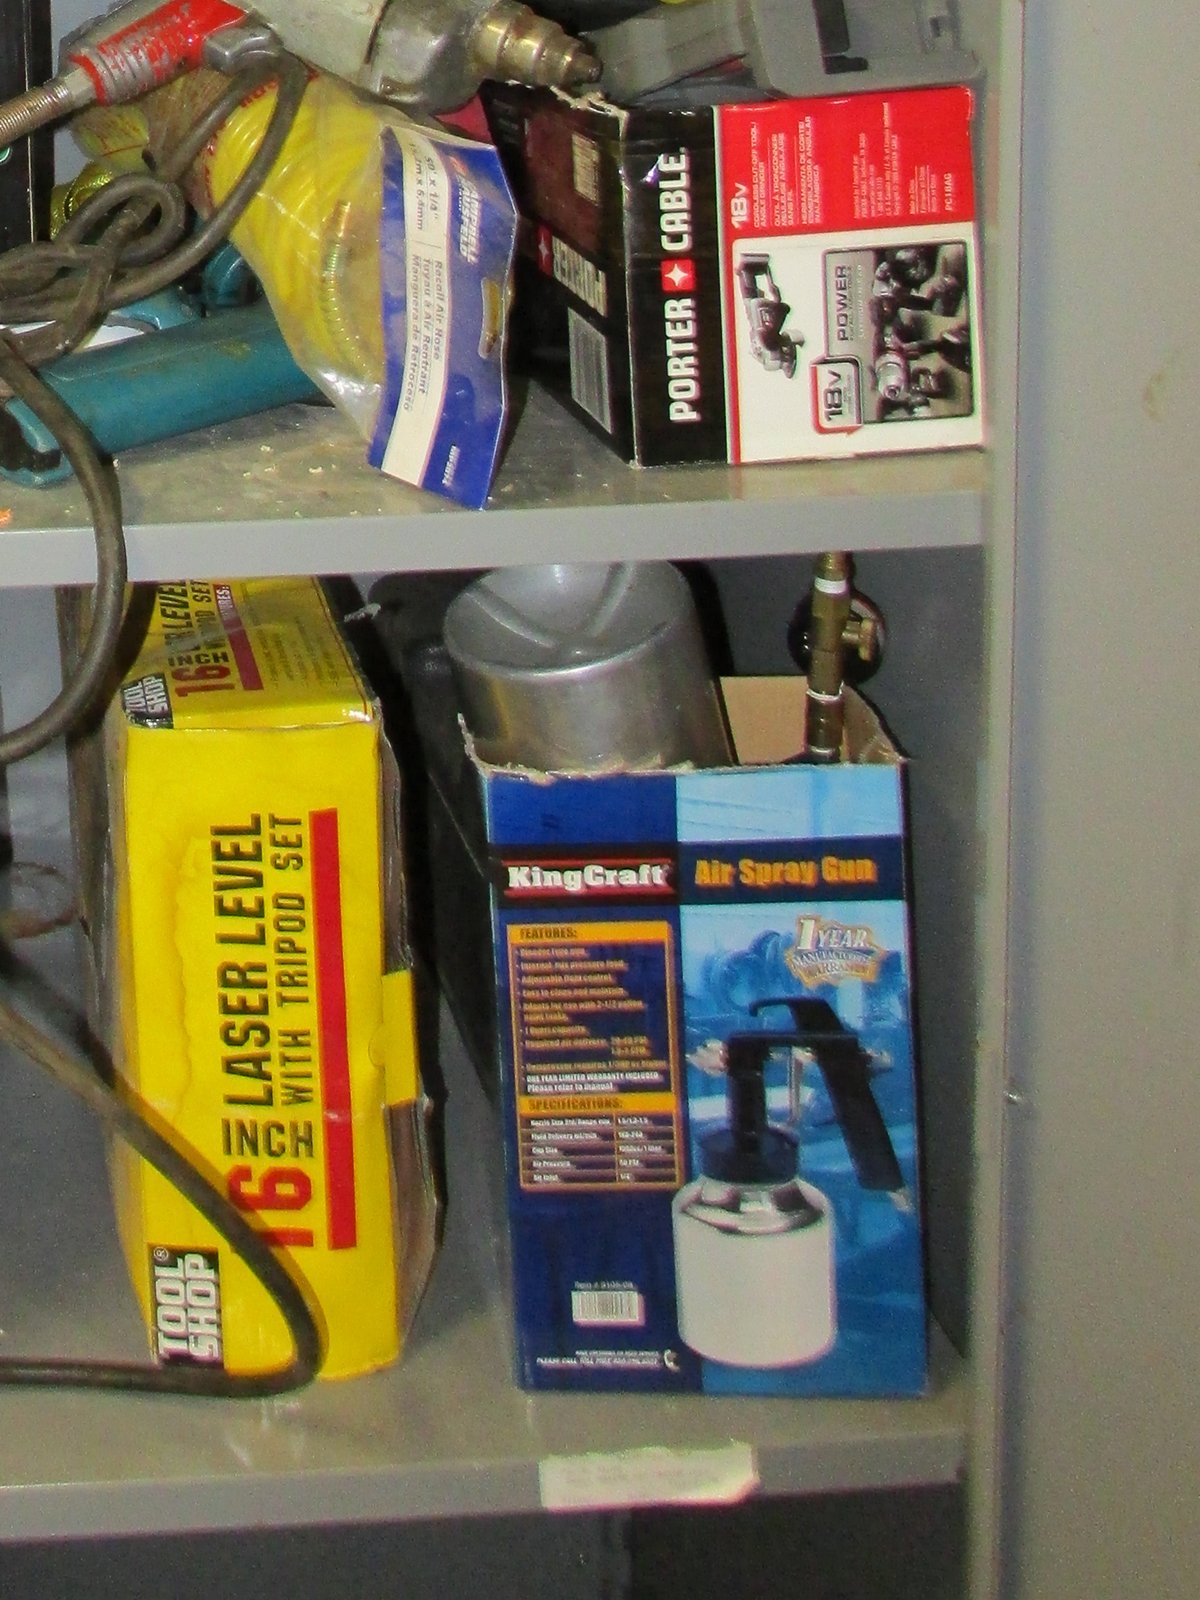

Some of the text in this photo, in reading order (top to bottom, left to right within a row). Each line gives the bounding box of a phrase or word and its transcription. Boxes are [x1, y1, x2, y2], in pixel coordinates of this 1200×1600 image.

[944, 173, 953, 211] PC18AG
[433, 260, 444, 360] Recoil Air Hose
[658, 153, 700, 423] PORTER CABLE
[835, 265, 848, 341] POWER
[403, 254, 421, 411] Manguera de Retroceso
[418, 258, 434, 394] Tuyau à Air Rentrant
[190, 580, 212, 603] SET
[168, 651, 229, 666] INCH
[171, 665, 235, 698] 16
[142, 676, 168, 713] SHOP
[508, 864, 665, 891] KingCraft
[695, 856, 875, 887] Air Spray Gun
[211, 812, 270, 1109] LASER LEVEL
[269, 810, 316, 1108] WITH TRIPOD SET
[520, 927, 578, 939] FEATURES:
[818, 928, 868, 948] YEAR
[222, 1116, 315, 1158] INCH
[228, 1163, 314, 1249] 16
[154, 1255, 189, 1359] TOOL
[183, 1253, 223, 1363] SHOP
